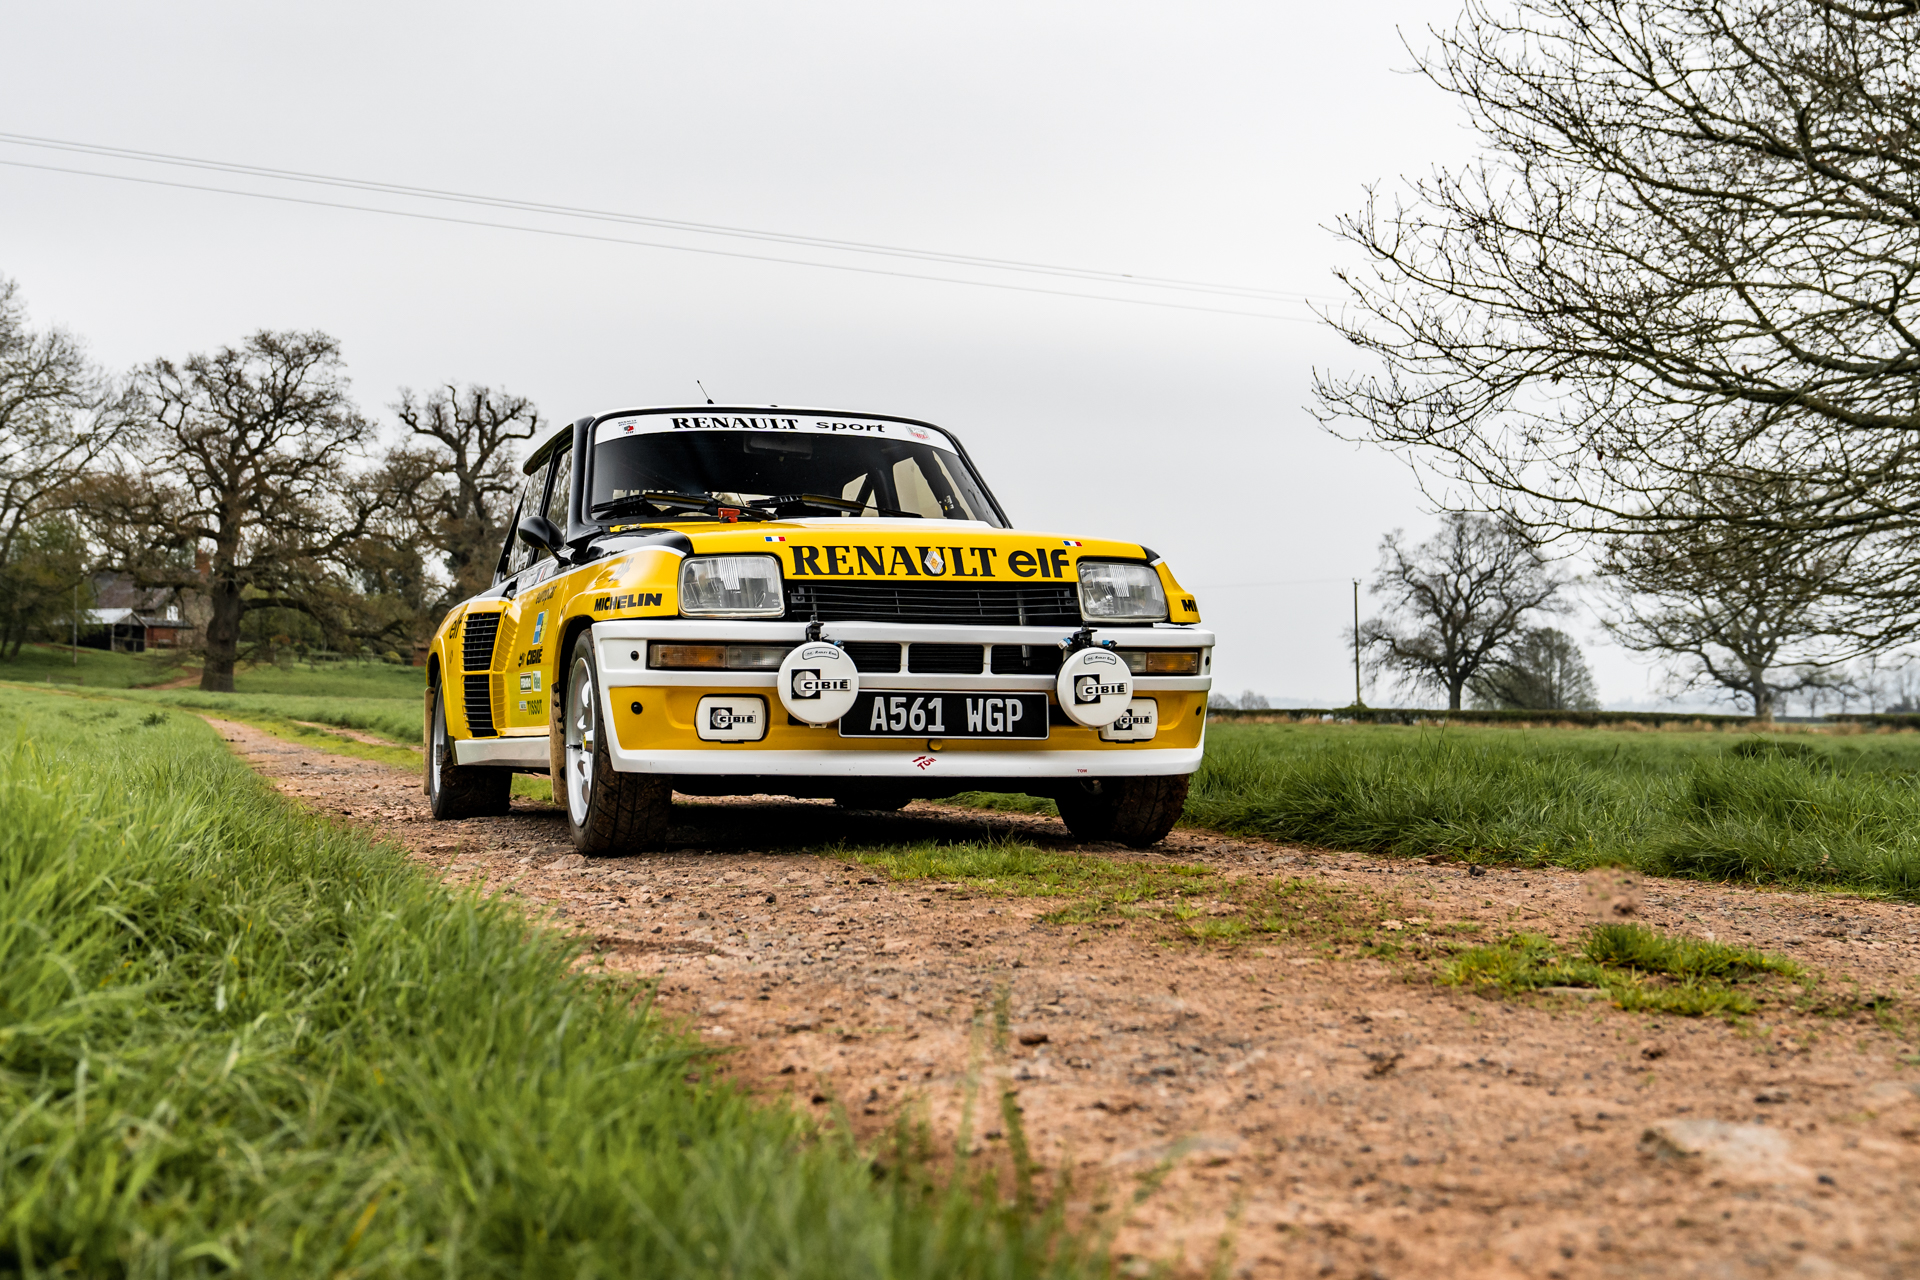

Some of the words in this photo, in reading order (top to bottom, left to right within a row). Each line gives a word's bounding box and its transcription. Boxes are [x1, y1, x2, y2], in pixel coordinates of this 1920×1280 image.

[669, 416, 799, 431] RENAULT
[815, 420, 886, 433] sport
[788, 545, 997, 578] RENAULT
[1007, 548, 1071, 578] elf
[593, 593, 663, 612] MICHELIN
[869, 696, 945, 732] A561
[965, 698, 1024, 732] WGP
[917, 757, 936, 770] TOW
